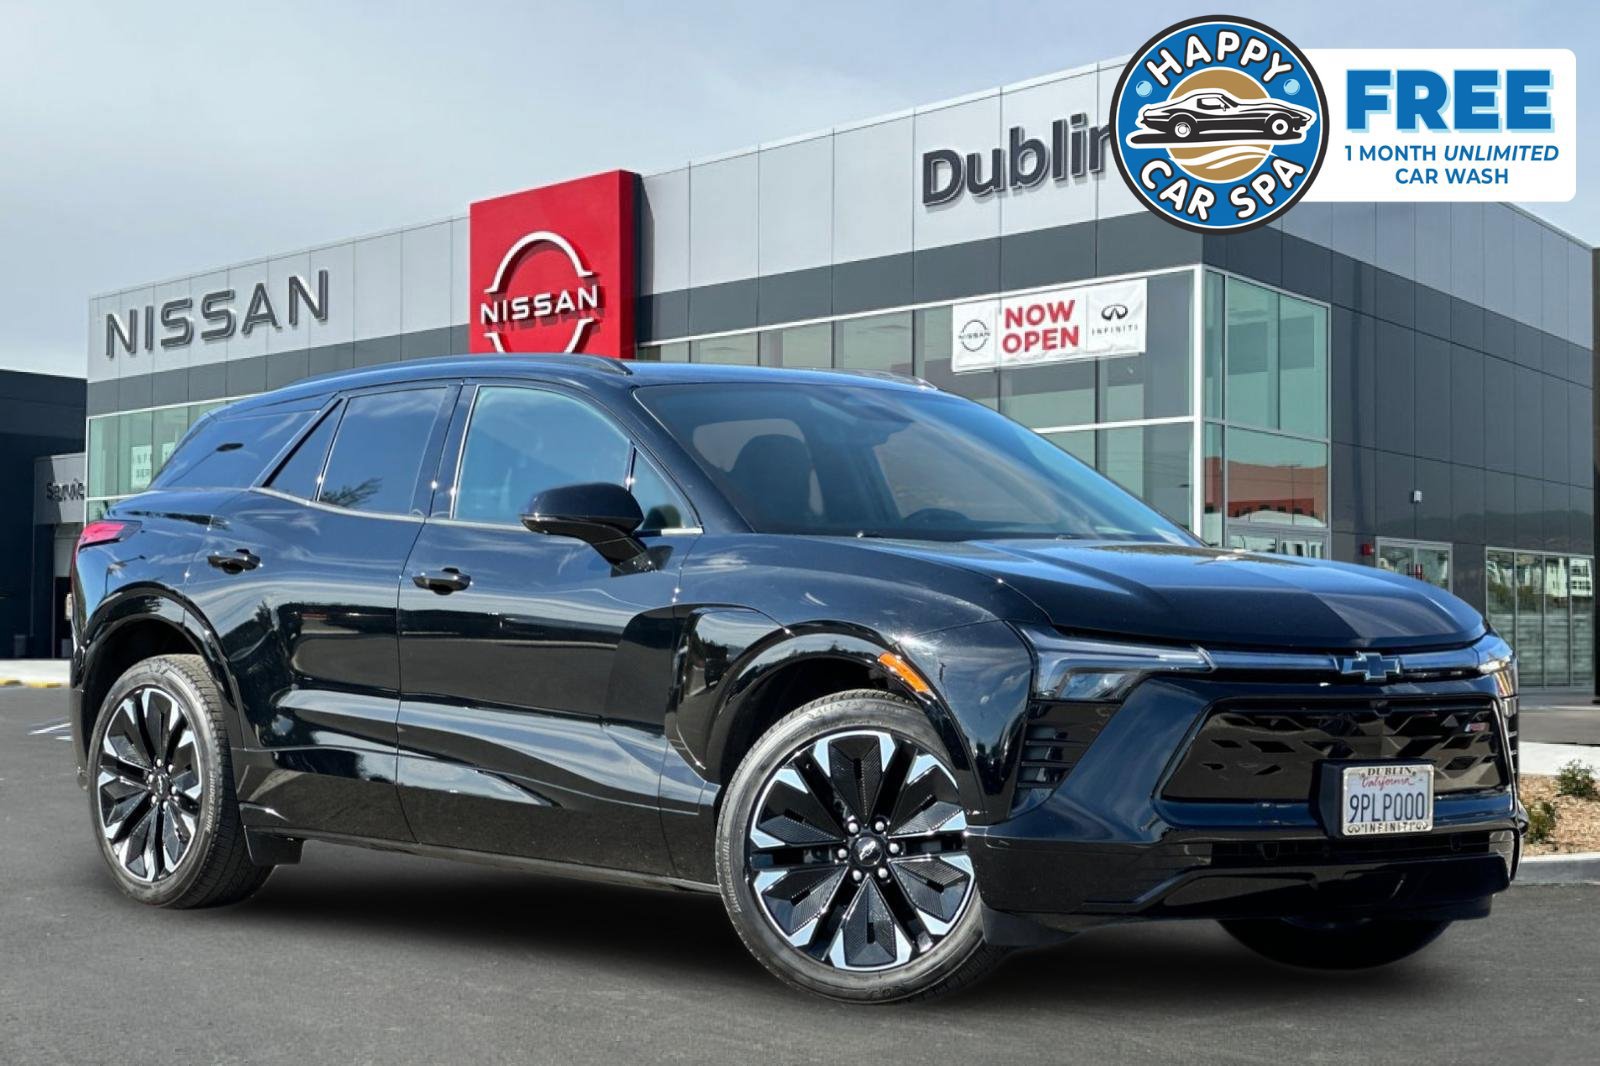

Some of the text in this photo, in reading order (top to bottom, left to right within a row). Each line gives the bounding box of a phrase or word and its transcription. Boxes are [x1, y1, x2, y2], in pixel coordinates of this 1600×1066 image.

[106, 270, 329, 358] NISSAN
[480, 285, 598, 325] NISSAN
[1005, 300, 1075, 329] NOW
[958, 332, 990, 340] NISSAN
[1002, 325, 1079, 353] OPEN
[1092, 324, 1138, 335] INFINITI
[1367, 767, 1412, 776] DUBLIN
[1361, 777, 1414, 790] California
[1348, 792, 1425, 823] 9PLP000
[1365, 823, 1413, 832] INFINITI
